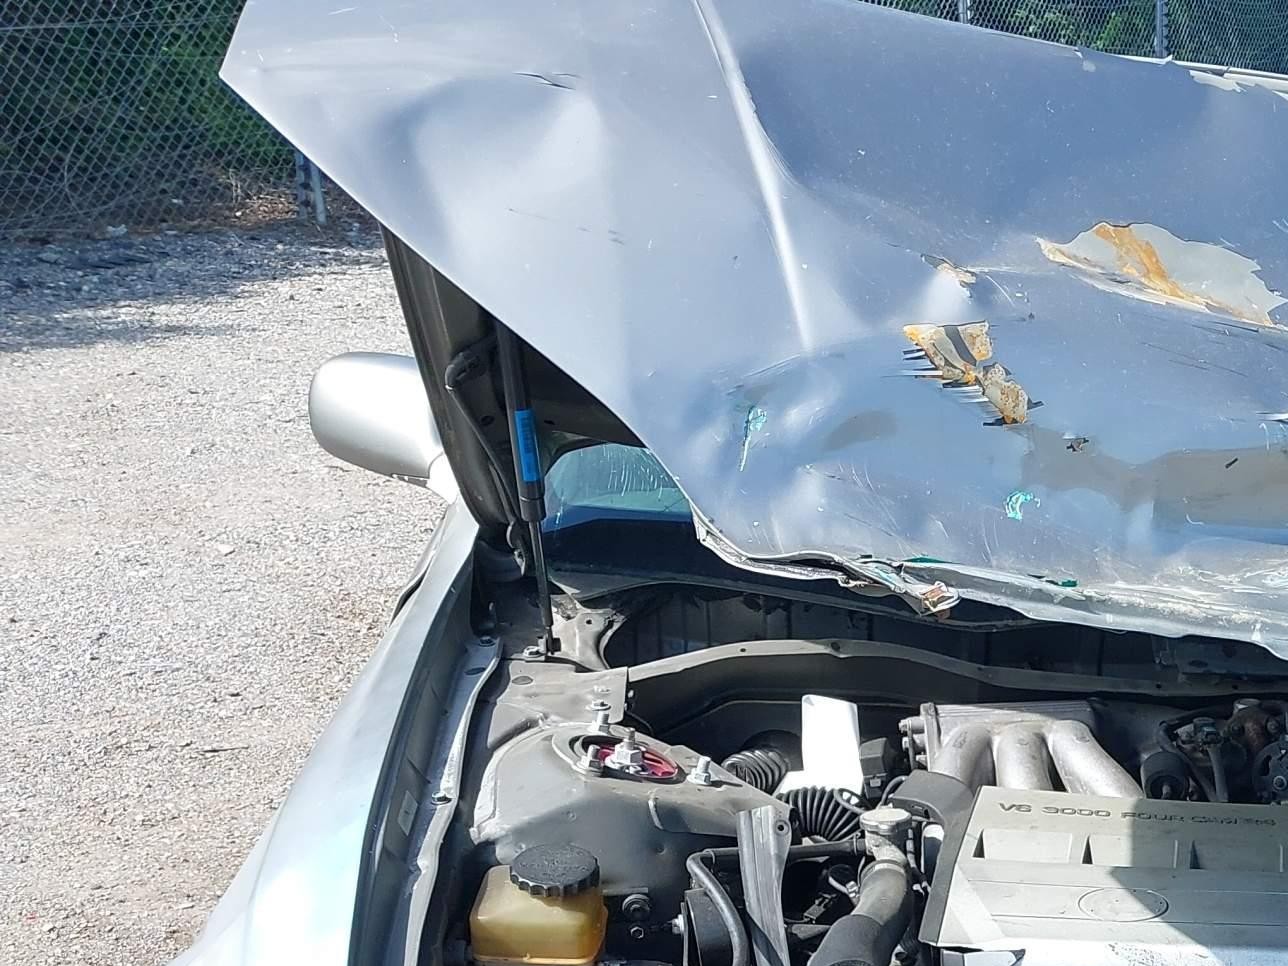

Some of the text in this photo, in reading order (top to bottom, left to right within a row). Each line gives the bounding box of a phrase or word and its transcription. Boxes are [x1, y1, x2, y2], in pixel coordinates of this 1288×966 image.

[998, 802, 1032, 813] V6
[1042, 806, 1111, 817] 3000
[1120, 811, 1185, 823] FOUR
